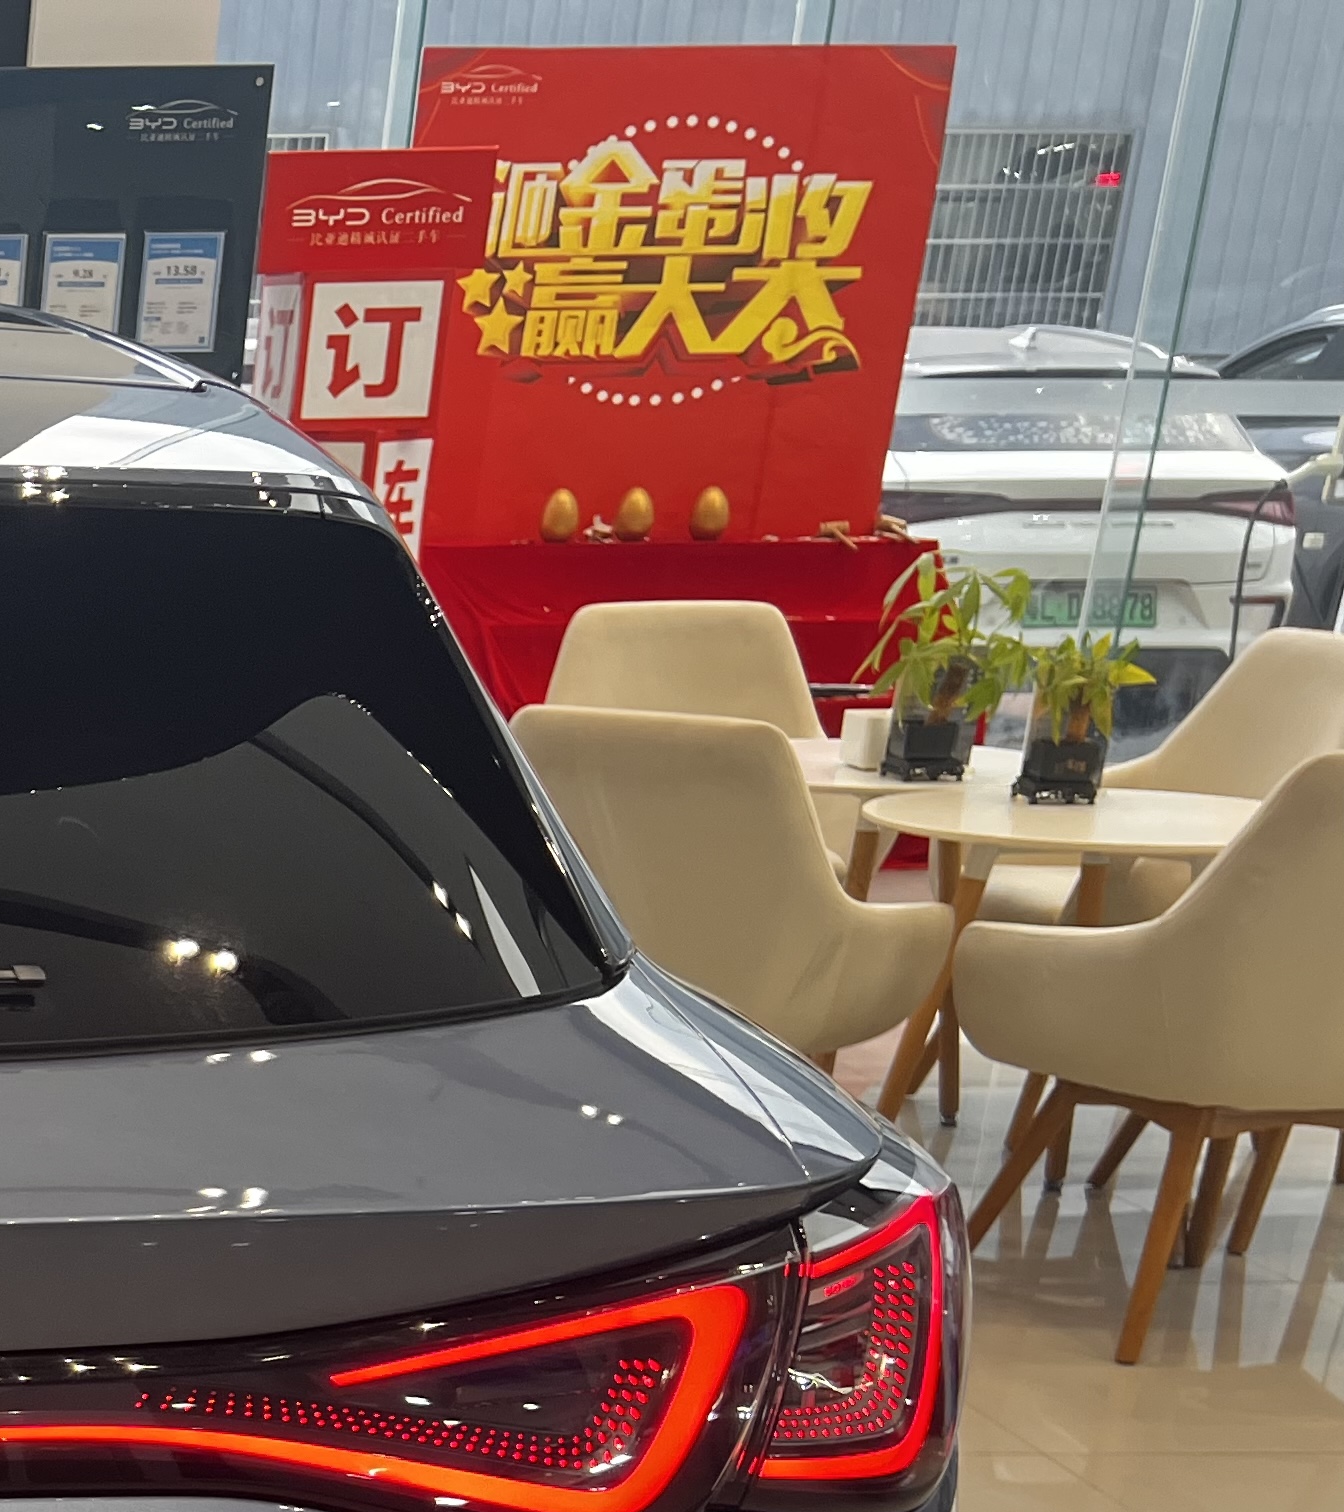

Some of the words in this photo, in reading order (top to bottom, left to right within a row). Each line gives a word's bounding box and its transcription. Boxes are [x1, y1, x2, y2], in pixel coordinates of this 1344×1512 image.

[440, 81, 486, 94] BYD
[128, 117, 177, 130] BYD
[183, 117, 234, 129] Certified
[291, 207, 371, 227] BYD
[381, 206, 464, 225] Certified
[326, 303, 422, 398] 订
